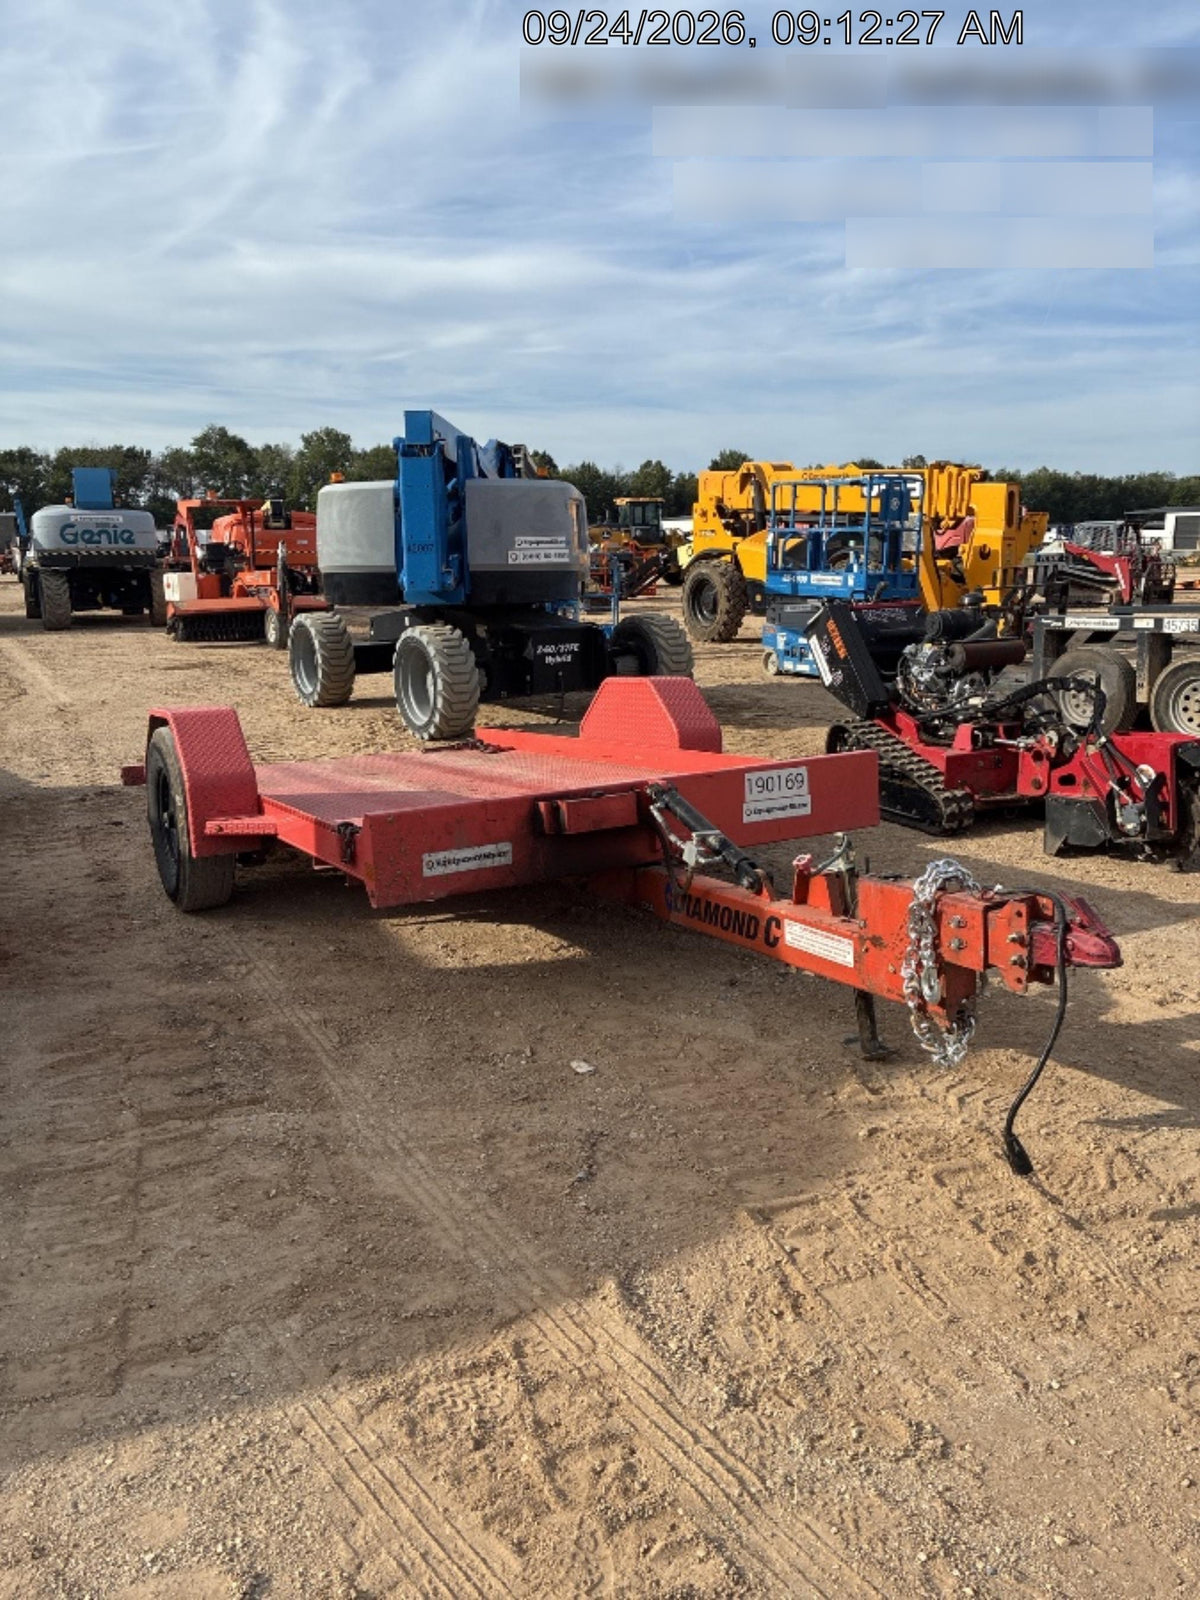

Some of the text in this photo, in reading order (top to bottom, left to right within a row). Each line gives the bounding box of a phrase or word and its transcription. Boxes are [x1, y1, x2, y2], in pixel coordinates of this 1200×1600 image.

[60, 523, 135, 545] Genie
[746, 772, 805, 795] 190169
[764, 915, 782, 949] C
